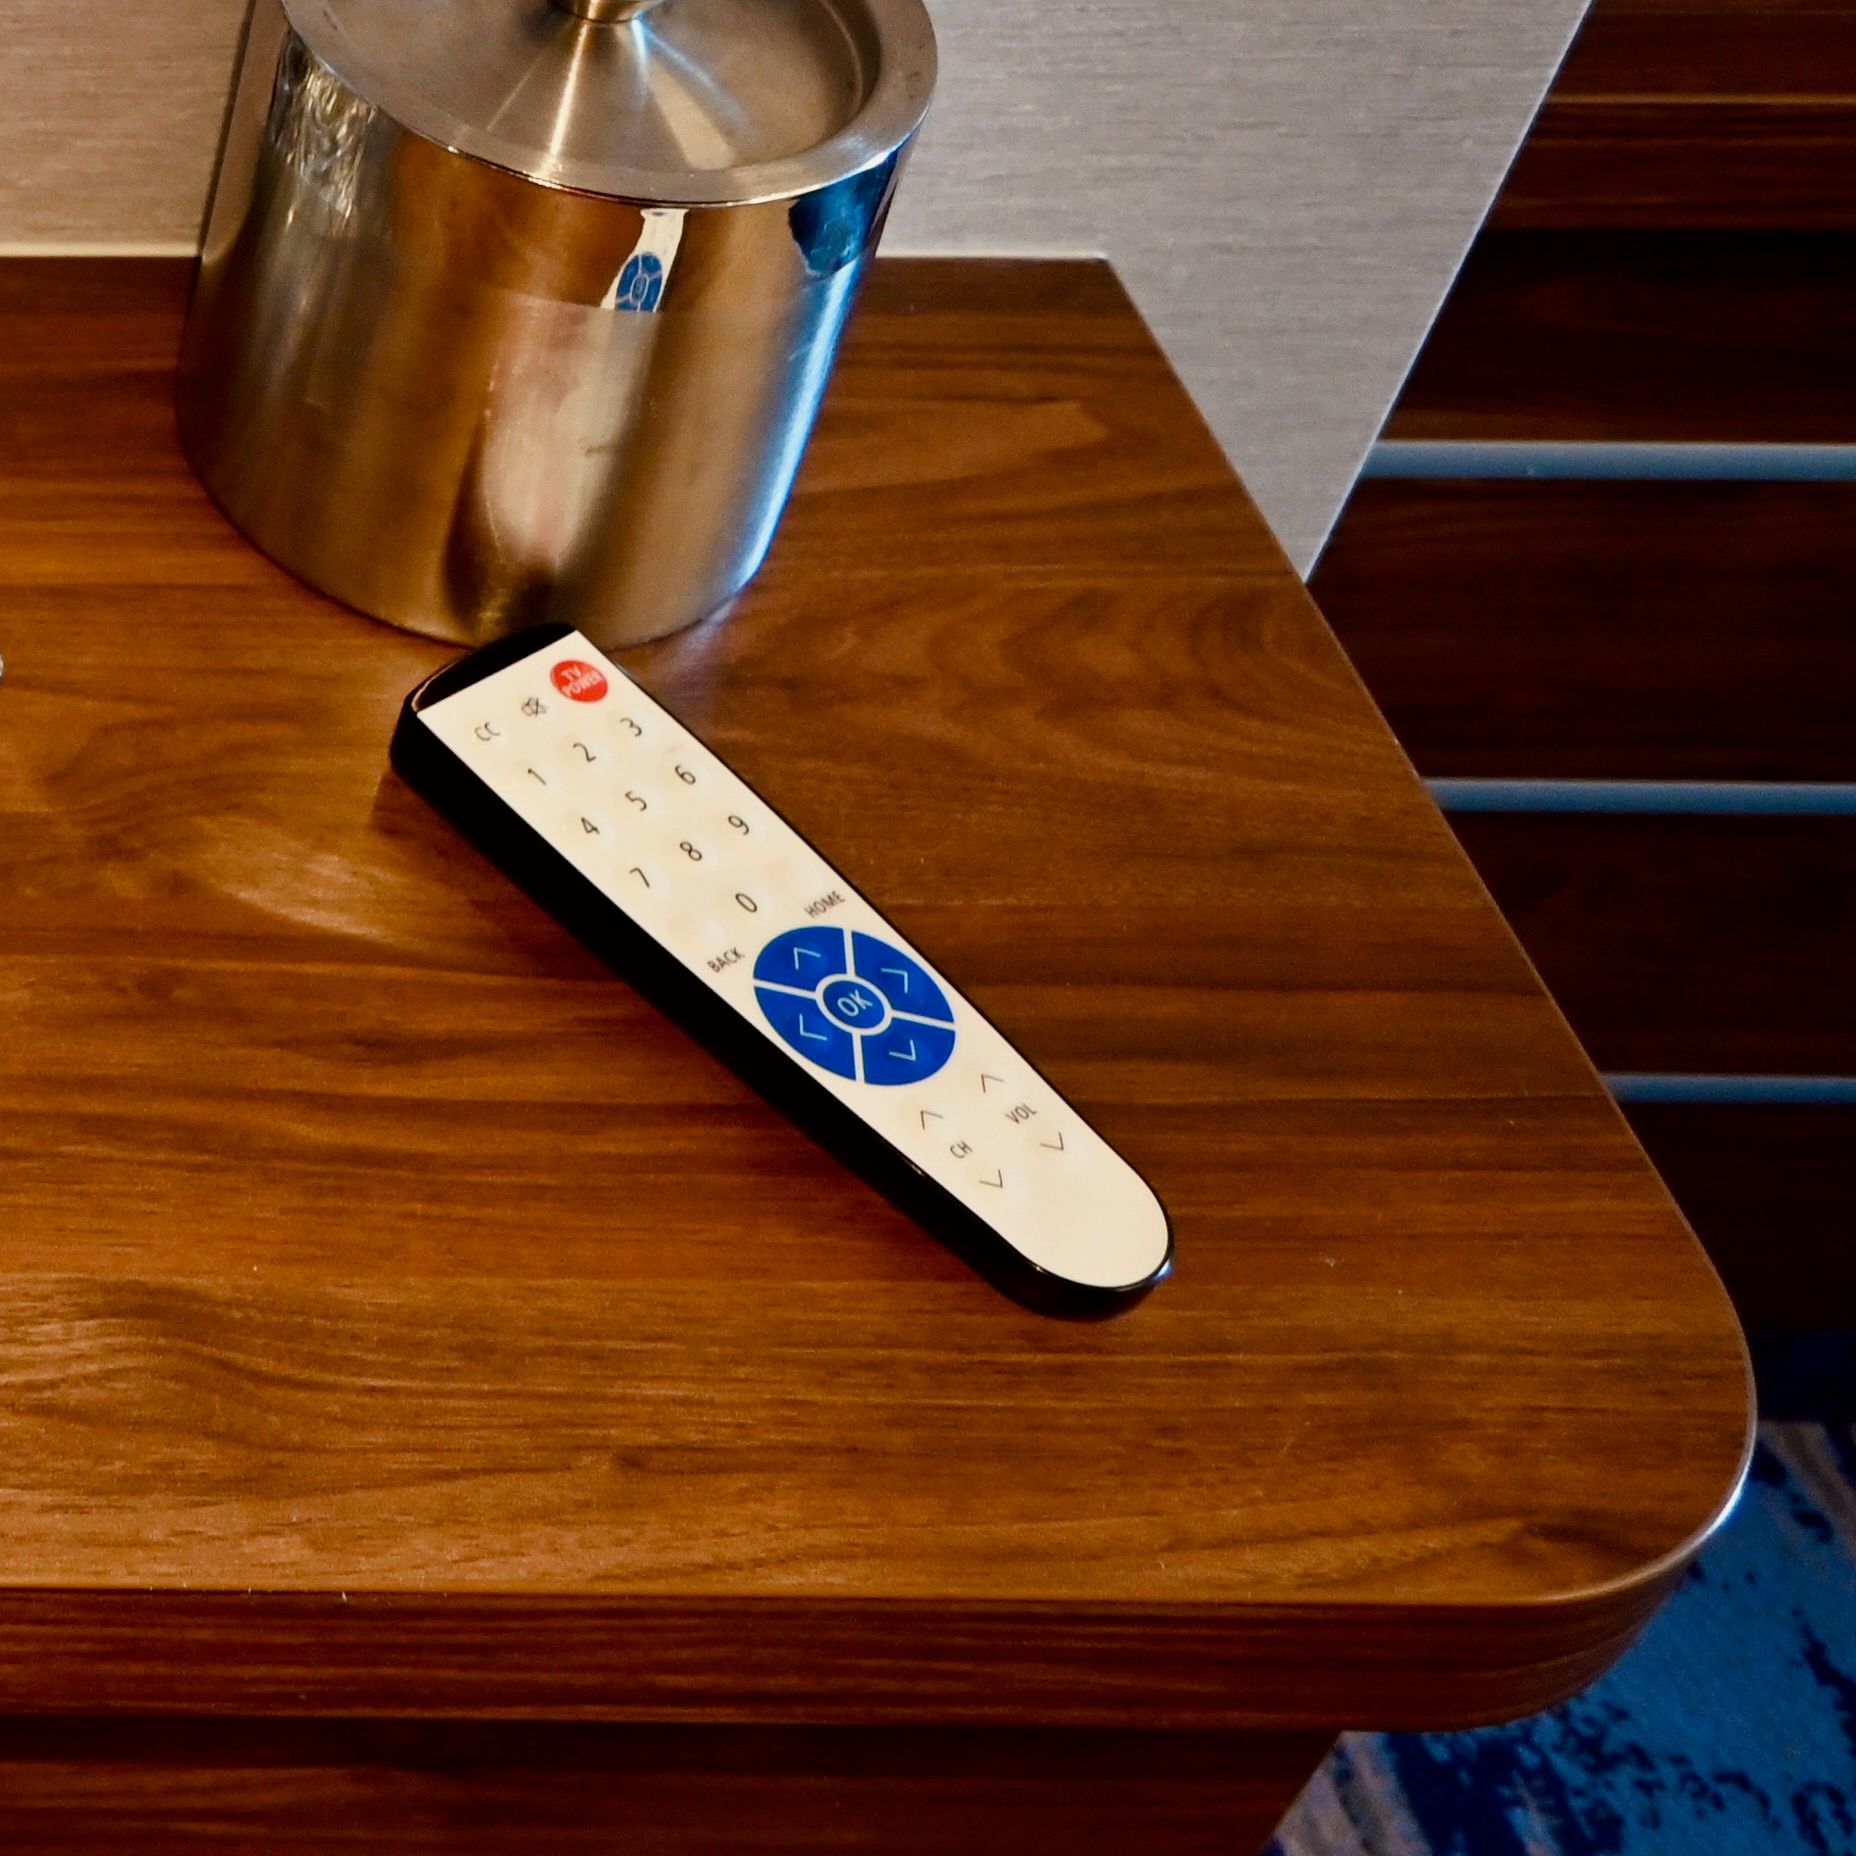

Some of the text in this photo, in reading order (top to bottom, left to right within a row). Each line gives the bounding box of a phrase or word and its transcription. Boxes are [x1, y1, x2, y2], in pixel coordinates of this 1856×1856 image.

[560, 665, 582, 682] TV
[562, 671, 602, 697] POWER
[474, 721, 501, 742] CC
[619, 717, 643, 737] 3
[573, 742, 596, 763] 2
[527, 767, 547, 786] 1
[674, 764, 697, 785] 6
[624, 790, 648, 812] 5
[580, 816, 600, 836] 4
[727, 814, 750, 836] 9
[679, 841, 703, 862] 8
[629, 867, 651, 889] 7
[735, 893, 758, 913] 0
[803, 890, 845, 918] HOME
[707, 946, 745, 974] BACK
[837, 989, 873, 1017] OK
[1005, 1103, 1038, 1124] VOL
[949, 1140, 973, 1160] CH
